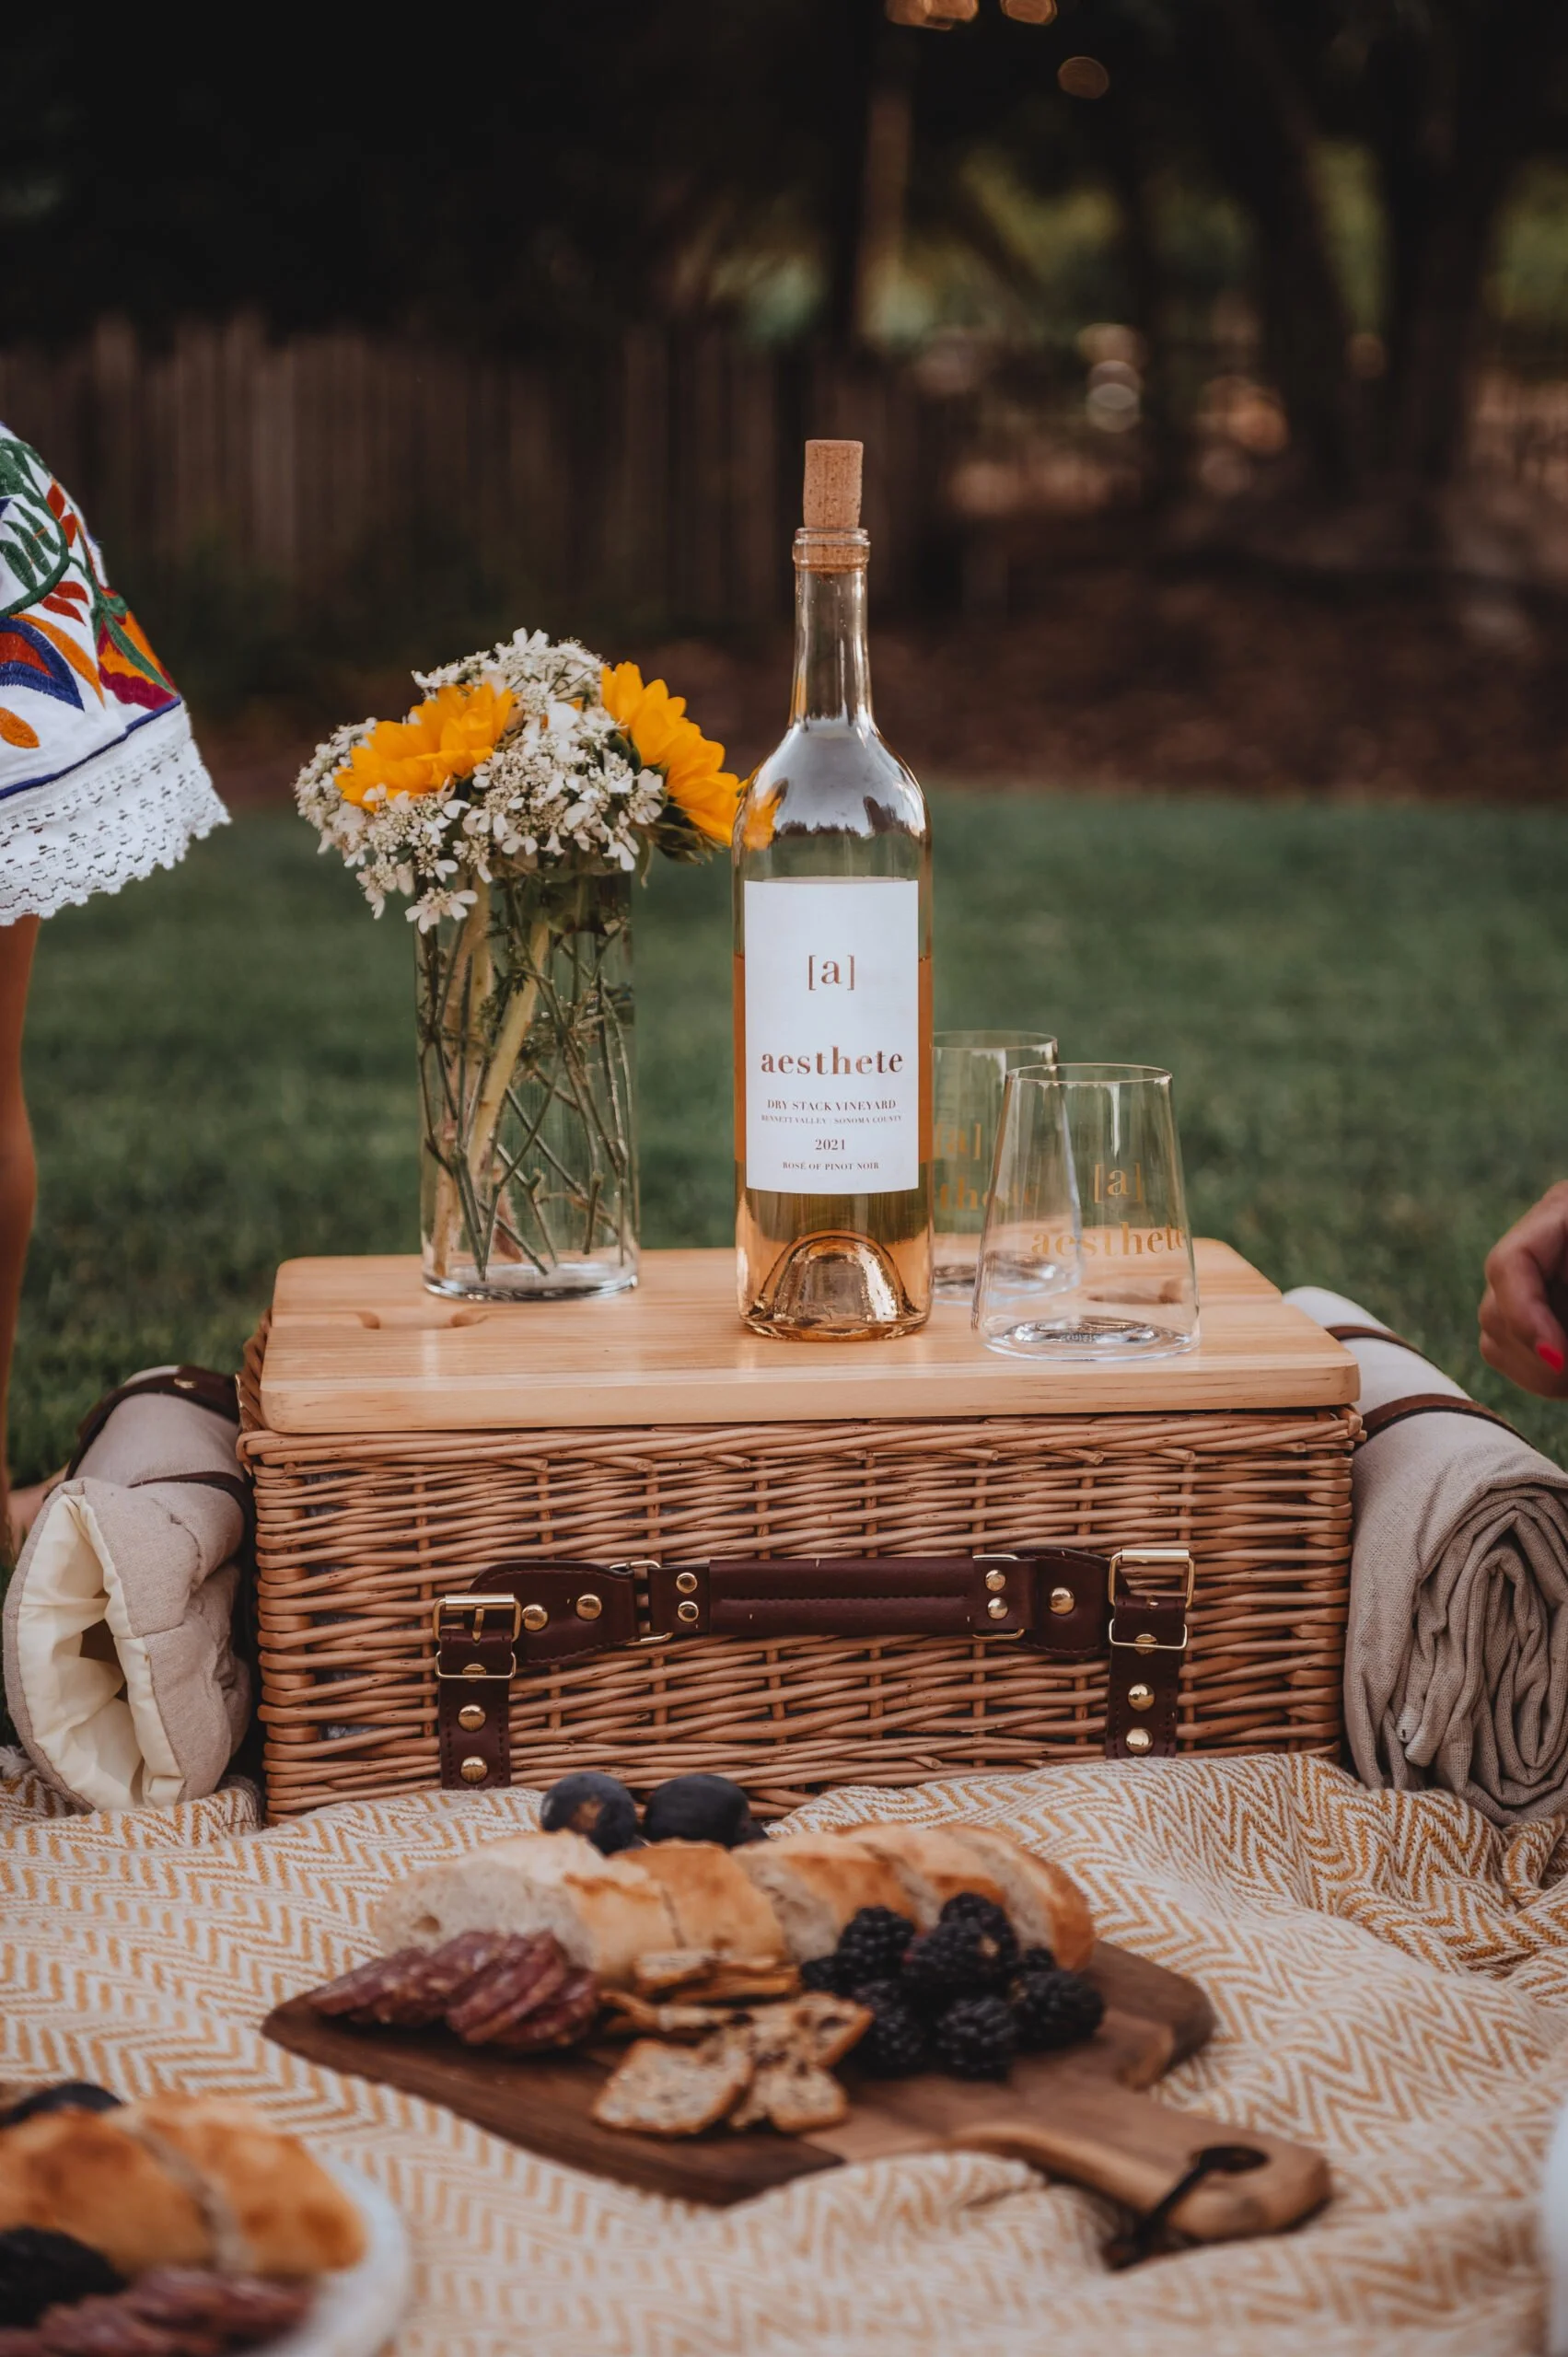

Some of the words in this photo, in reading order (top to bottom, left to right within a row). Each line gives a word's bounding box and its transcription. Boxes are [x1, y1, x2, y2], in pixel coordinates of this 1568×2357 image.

[808, 955, 855, 991] [a]
[761, 1046, 903, 1075] aesthete
[767, 1098, 788, 1110] DRY
[792, 1100, 832, 1111] STACK
[835, 1098, 897, 1111] VINEYARD
[833, 1116, 870, 1124] SONOMA
[872, 1114, 901, 1124] COUNTY
[815, 1138, 845, 1151] 2021
[808, 1163, 821, 1171] OF
[825, 1162, 854, 1171] PINOT
[856, 1161, 879, 1170] NOIR
[1093, 1162, 1144, 1203] [a]
